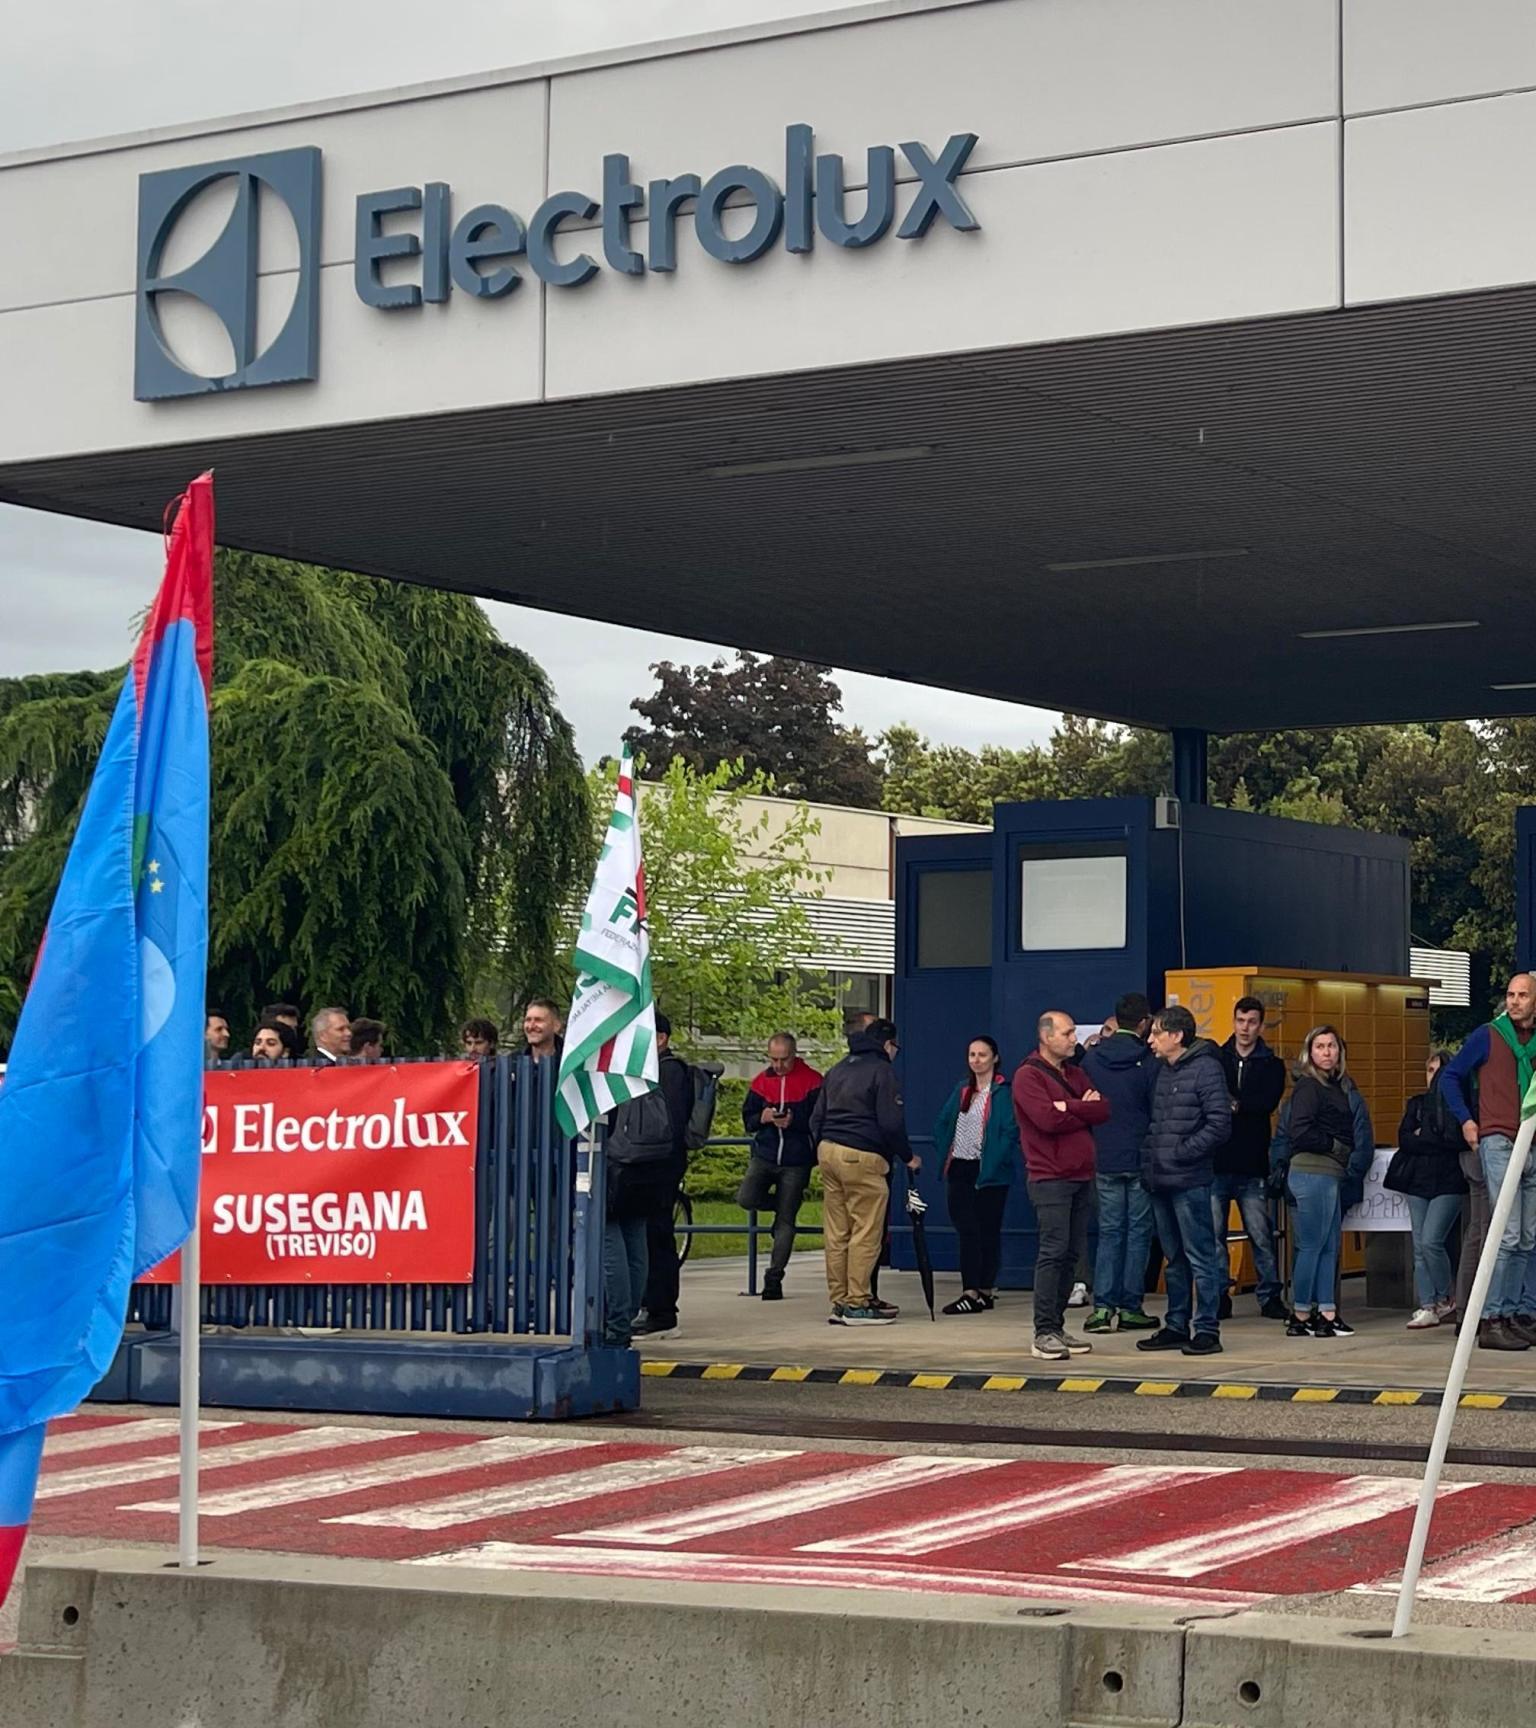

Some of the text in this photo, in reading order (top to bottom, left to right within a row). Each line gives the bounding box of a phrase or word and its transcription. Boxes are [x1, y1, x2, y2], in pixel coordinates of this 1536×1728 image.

[355, 123, 982, 310] Electrolux
[233, 1097, 470, 1153] Electrolux
[213, 1189, 428, 1235] SUSEGANA
[266, 1231, 377, 1261] (TREVISO)
